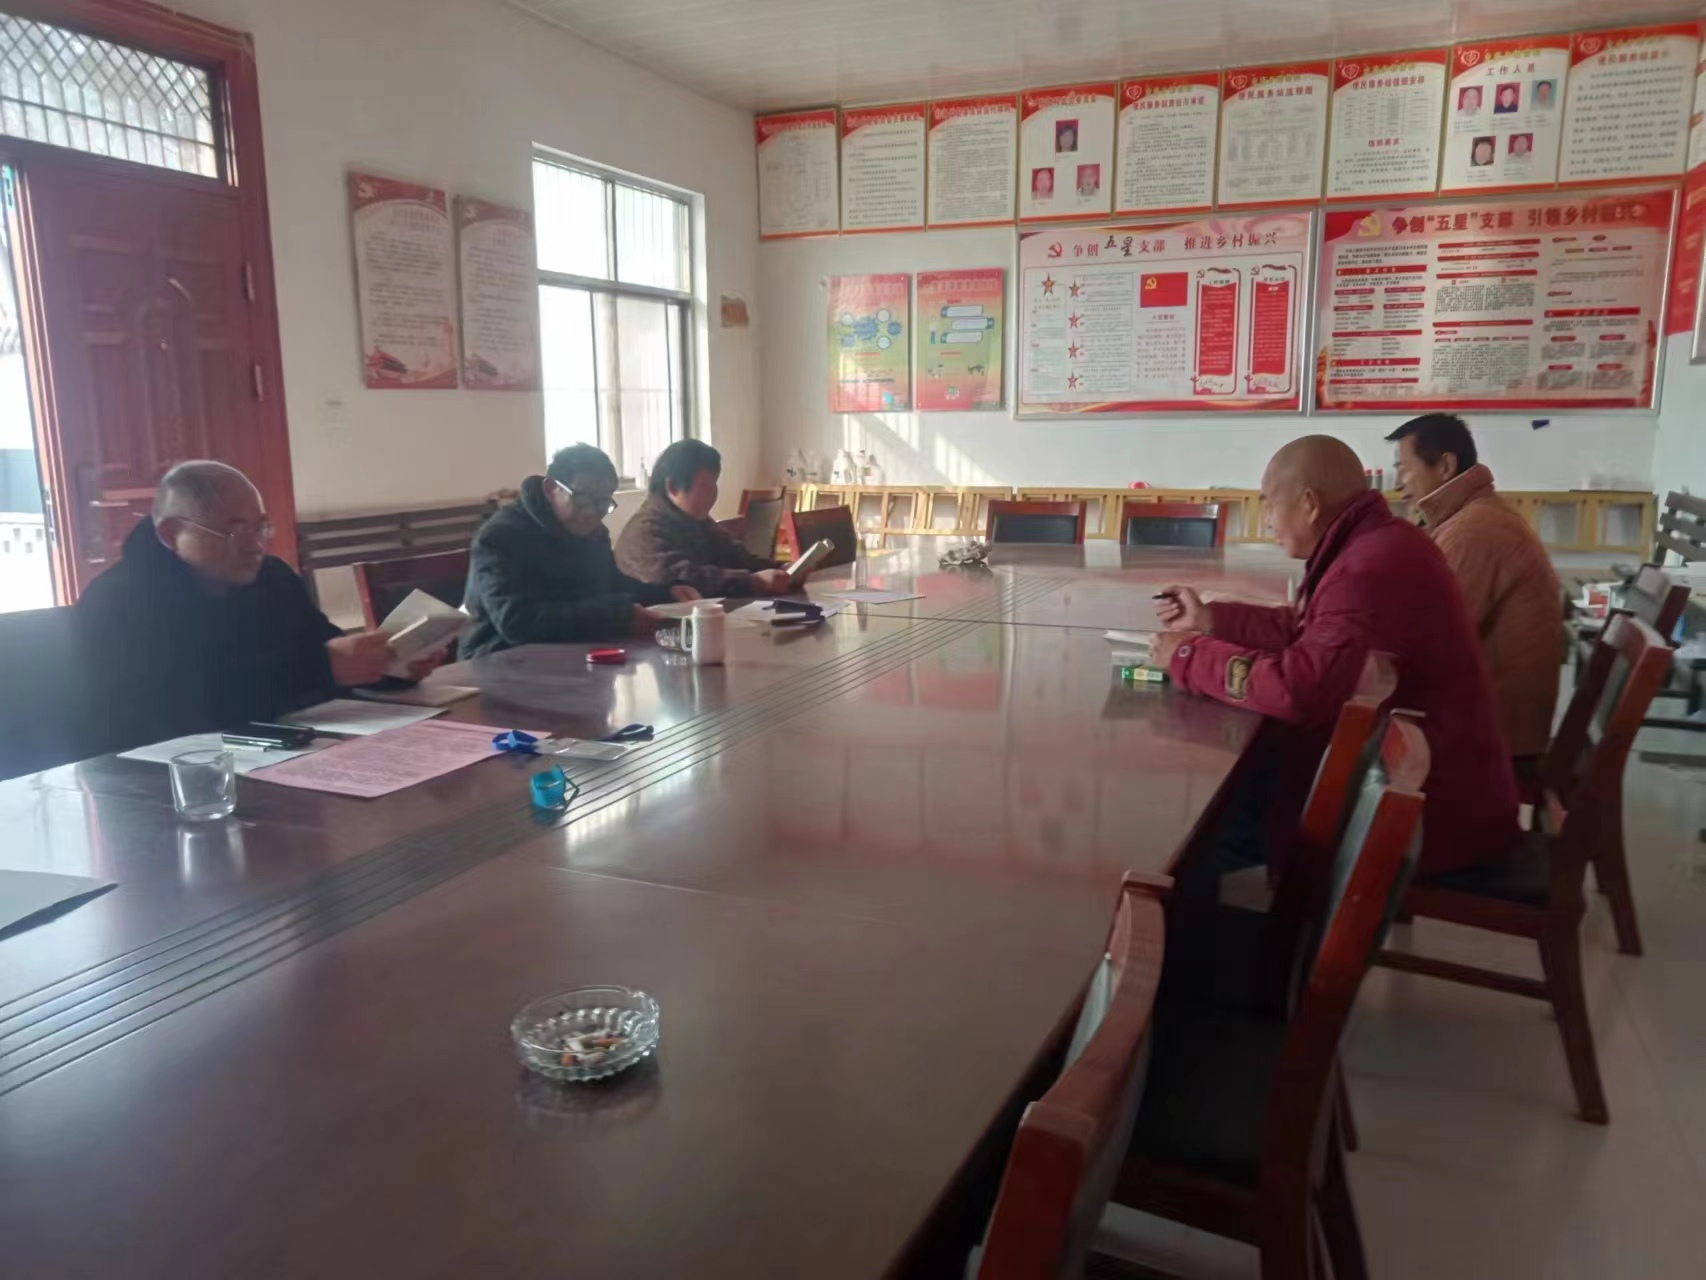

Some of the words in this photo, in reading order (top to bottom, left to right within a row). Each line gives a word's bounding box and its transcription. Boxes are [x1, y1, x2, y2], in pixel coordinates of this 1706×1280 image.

[1486, 63, 1535, 76] 工作人员
[1184, 231, 1278, 250] 推进乡村振兴
